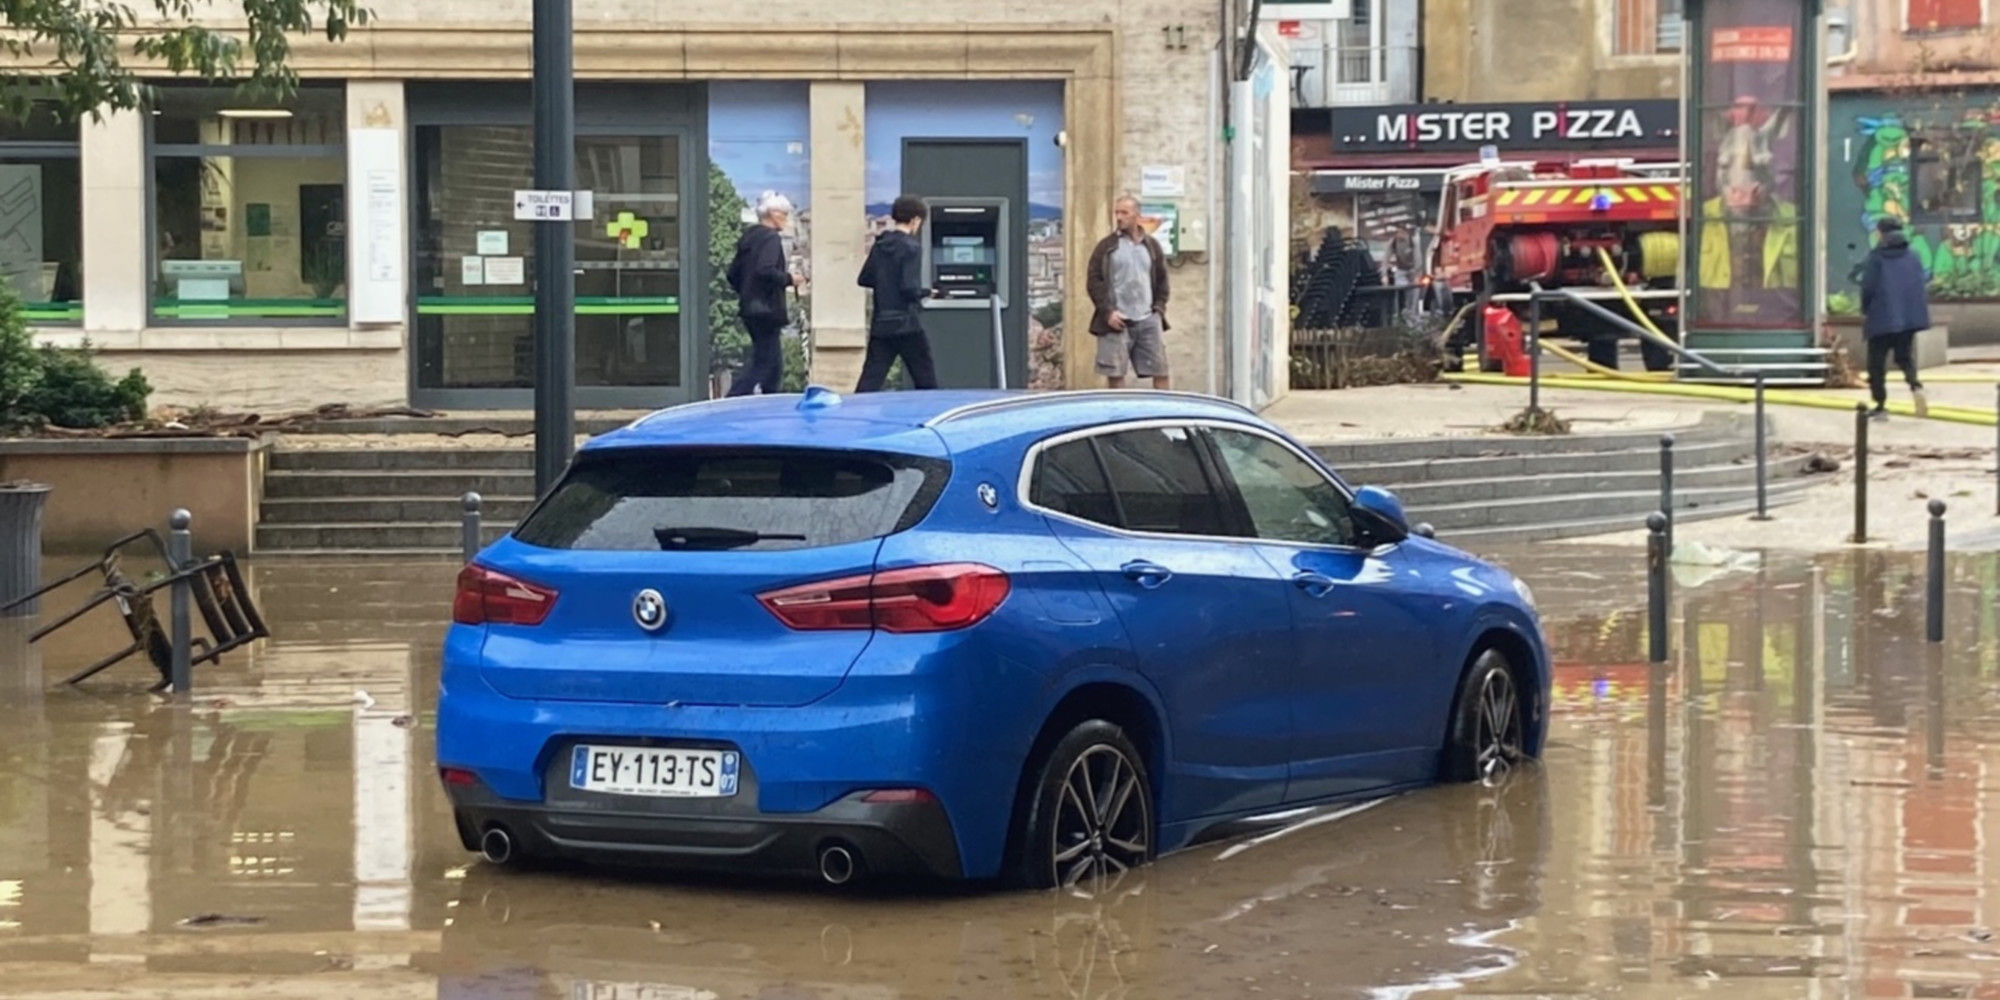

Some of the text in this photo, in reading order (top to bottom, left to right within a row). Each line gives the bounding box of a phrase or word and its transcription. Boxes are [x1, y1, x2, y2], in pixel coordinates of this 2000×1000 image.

[1161, 25, 1188, 49] 11
[1345, 176, 1420, 189] Mister Pizza
[528, 194, 570, 204] TOILETTES
[592, 752, 716, 787] EY-113-TS
[721, 774, 734, 790] 07
